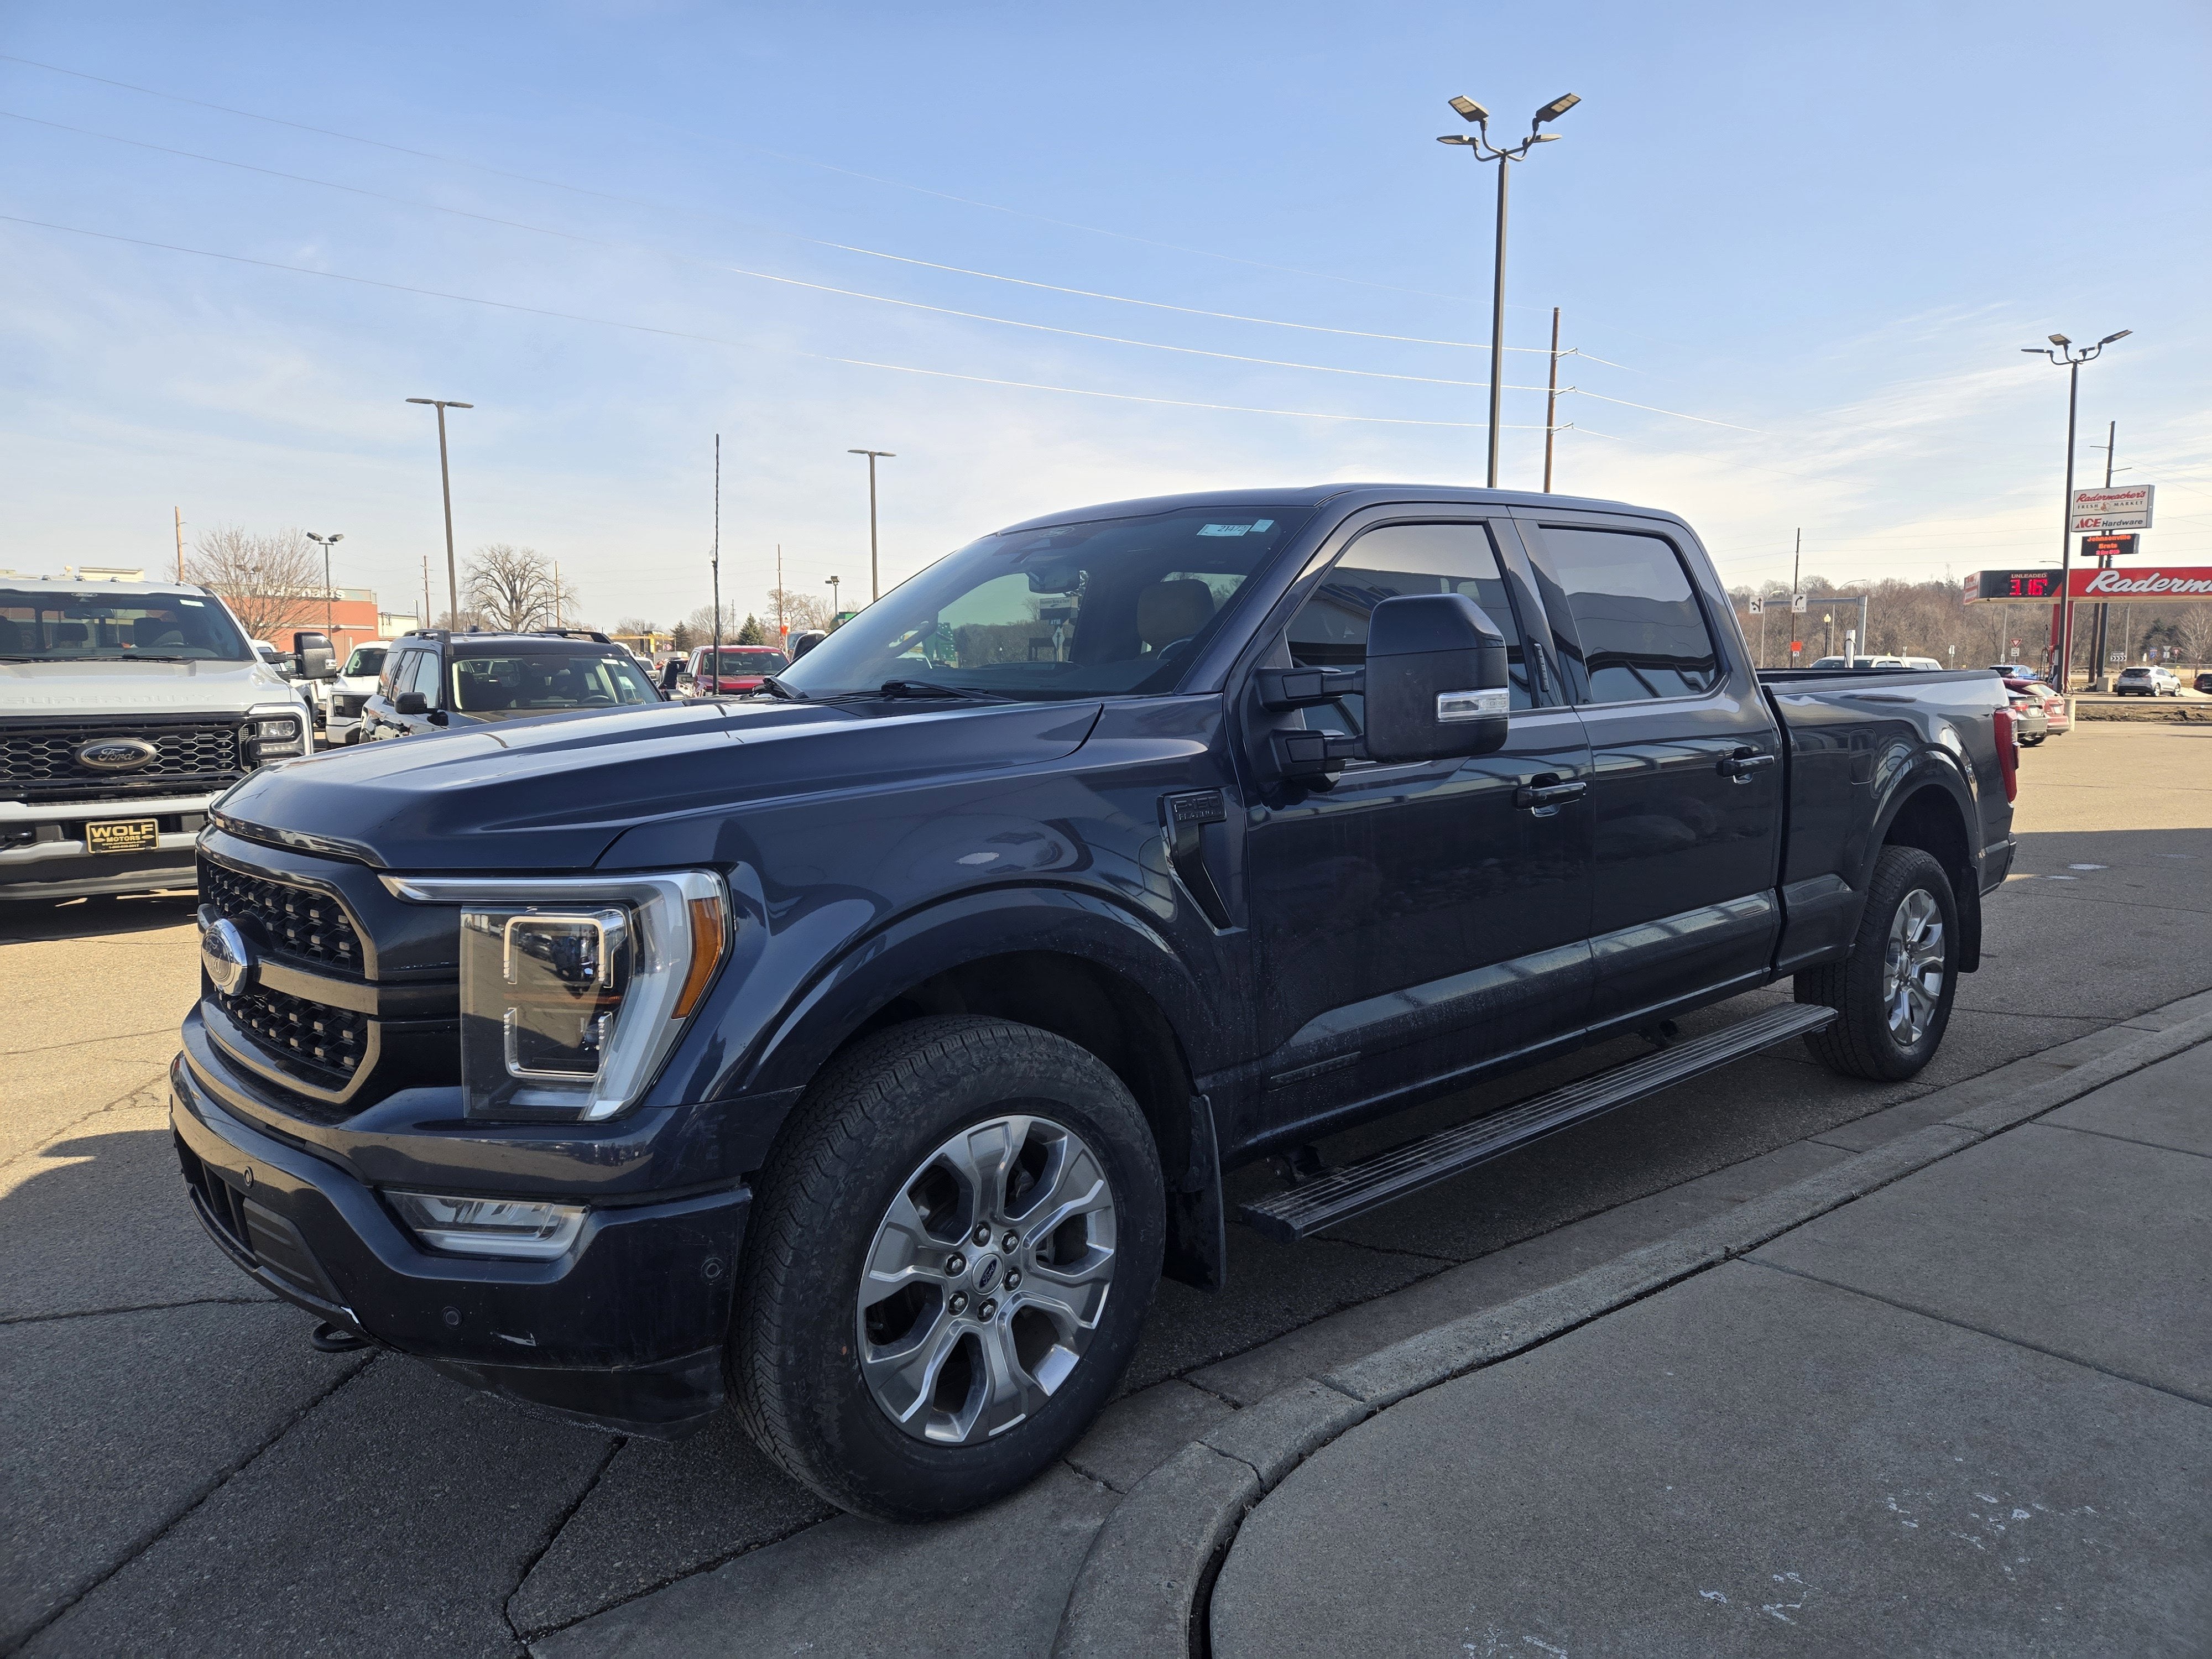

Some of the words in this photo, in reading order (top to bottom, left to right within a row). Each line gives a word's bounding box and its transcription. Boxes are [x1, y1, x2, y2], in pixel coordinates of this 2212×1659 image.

[2076, 490, 2146, 503] Radermacher's
[2075, 518, 2102, 529] ACE
[2101, 519, 2143, 528] Hardware
[2, 695, 123, 705] SUPER
[128, 693, 215, 704] DUTY
[98, 748, 135, 761] Ford
[1173, 796, 1220, 813] F-150
[91, 823, 153, 838] WOLF
[982, 1263, 995, 1285] Ford
